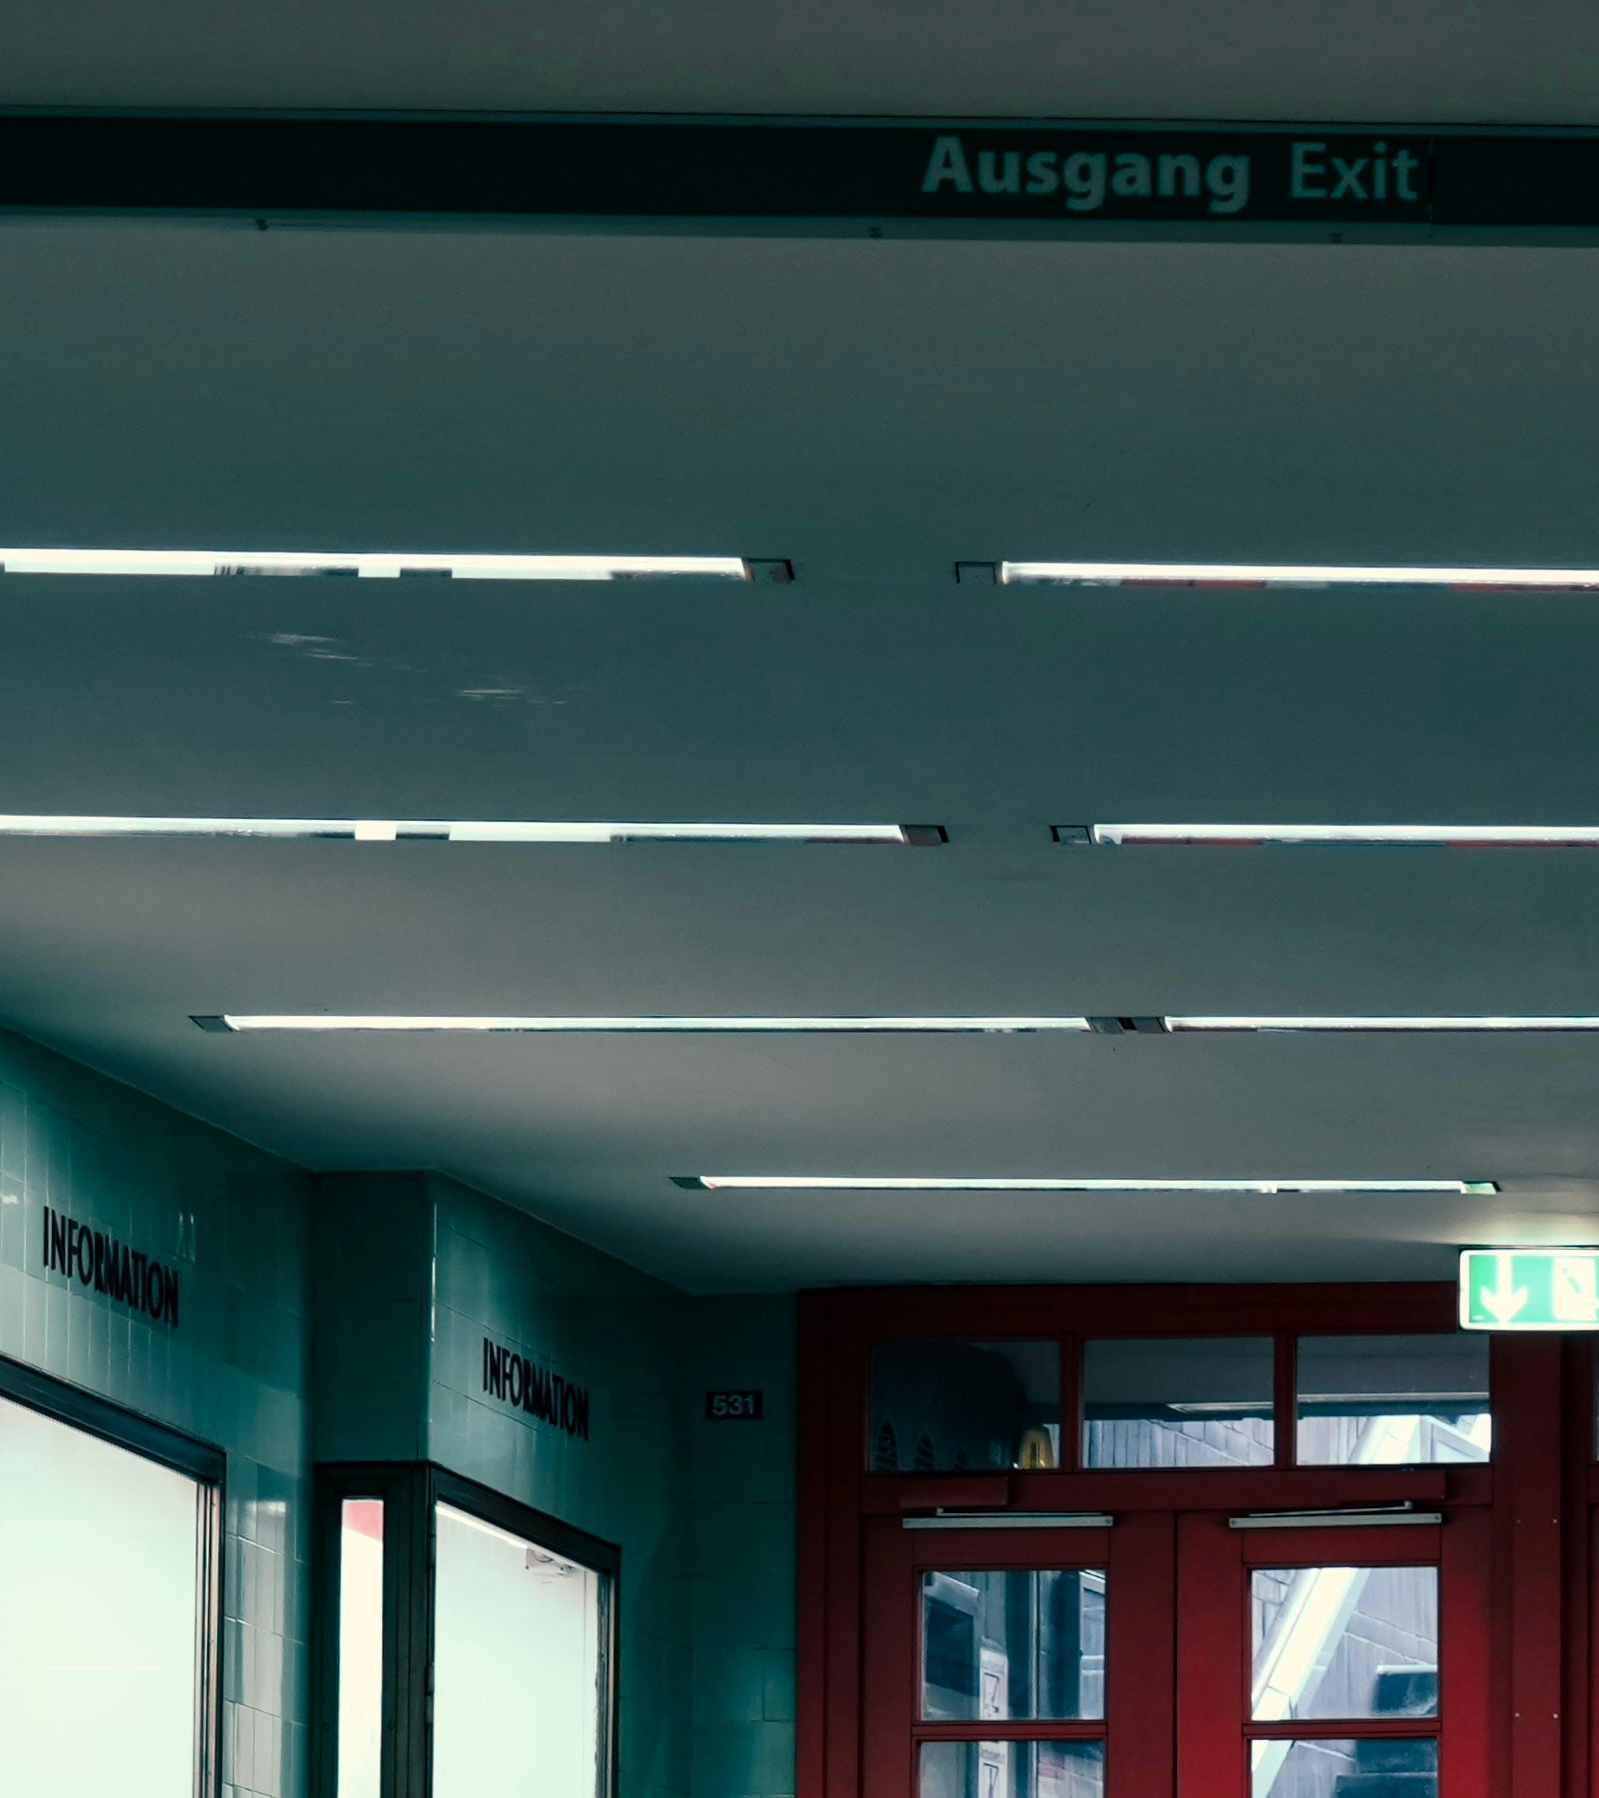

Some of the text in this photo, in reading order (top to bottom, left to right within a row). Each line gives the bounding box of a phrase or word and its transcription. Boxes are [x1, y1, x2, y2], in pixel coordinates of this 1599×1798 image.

[921, 136, 1419, 214] Ausgang Exit
[43, 1205, 179, 1329] INFORMATION
[482, 1337, 590, 1441] INFORMATION
[712, 1394, 754, 1416] 531
